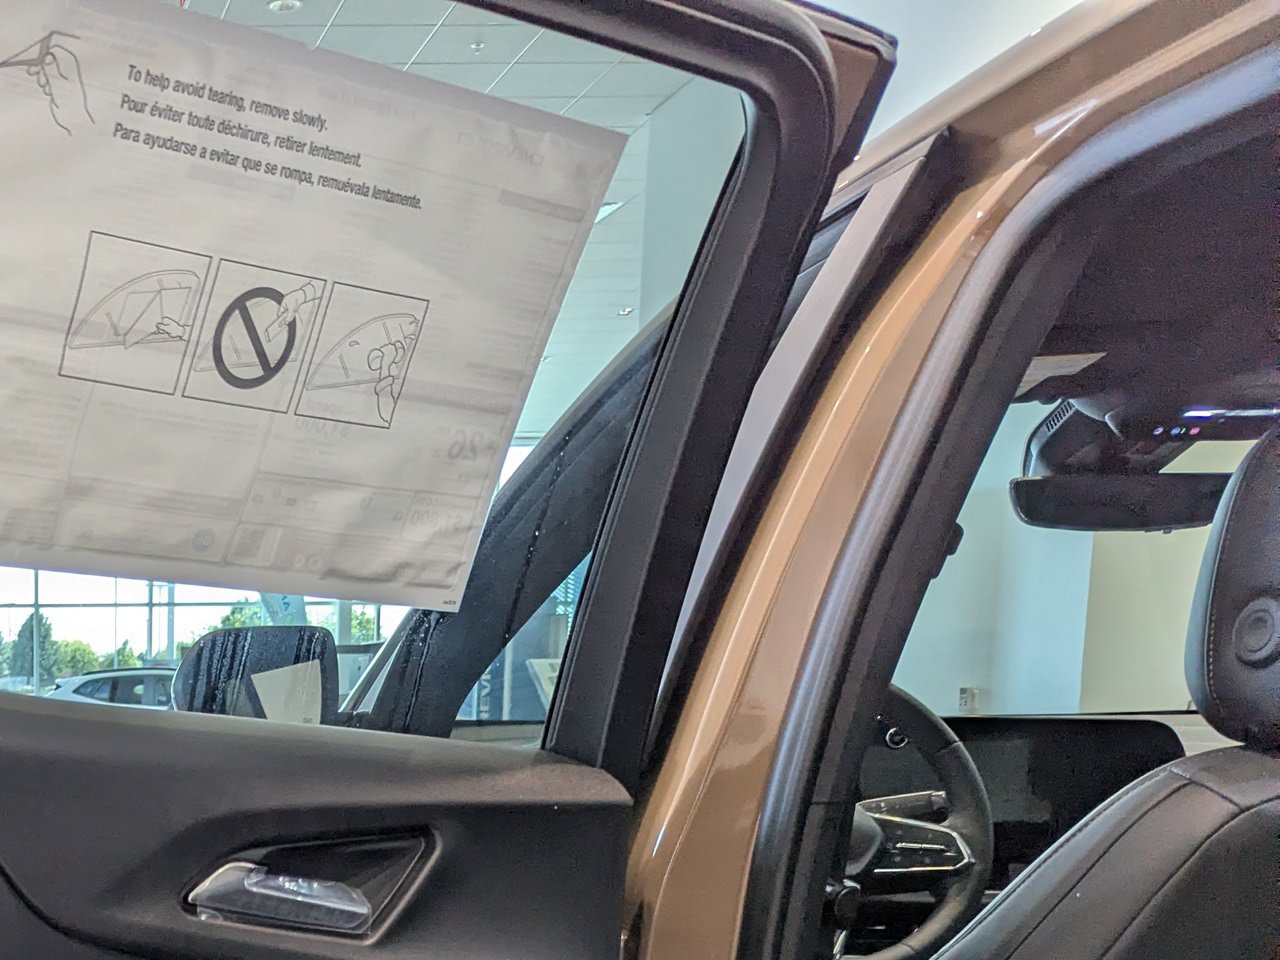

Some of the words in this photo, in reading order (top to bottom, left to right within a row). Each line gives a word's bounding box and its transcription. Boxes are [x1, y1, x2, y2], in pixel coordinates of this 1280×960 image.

[120, 94, 149, 114] Pour
[150, 101, 186, 123] éviter
[187, 112, 216, 132] toute
[217, 119, 271, 147] déchirure,
[274, 134, 307, 153] retirer
[308, 138, 362, 168] lentement.
[128, 64, 142, 83] To
[144, 69, 170, 92] help
[173, 79, 206, 99] avoid
[208, 86, 246, 112] tearing,
[250, 98, 290, 121] remove
[292, 109, 328, 132] slowly.
[113, 122, 141, 142] Para
[143, 132, 198, 157] ayudarse
[199, 147, 207, 158] a
[209, 148, 240, 167] evitar
[241, 158, 262, 173] que
[264, 161, 278, 175] se
[280, 164, 314, 187] rompa,
[317, 174, 370, 197] remuévala
[371, 185, 422, 210] lentamente.
